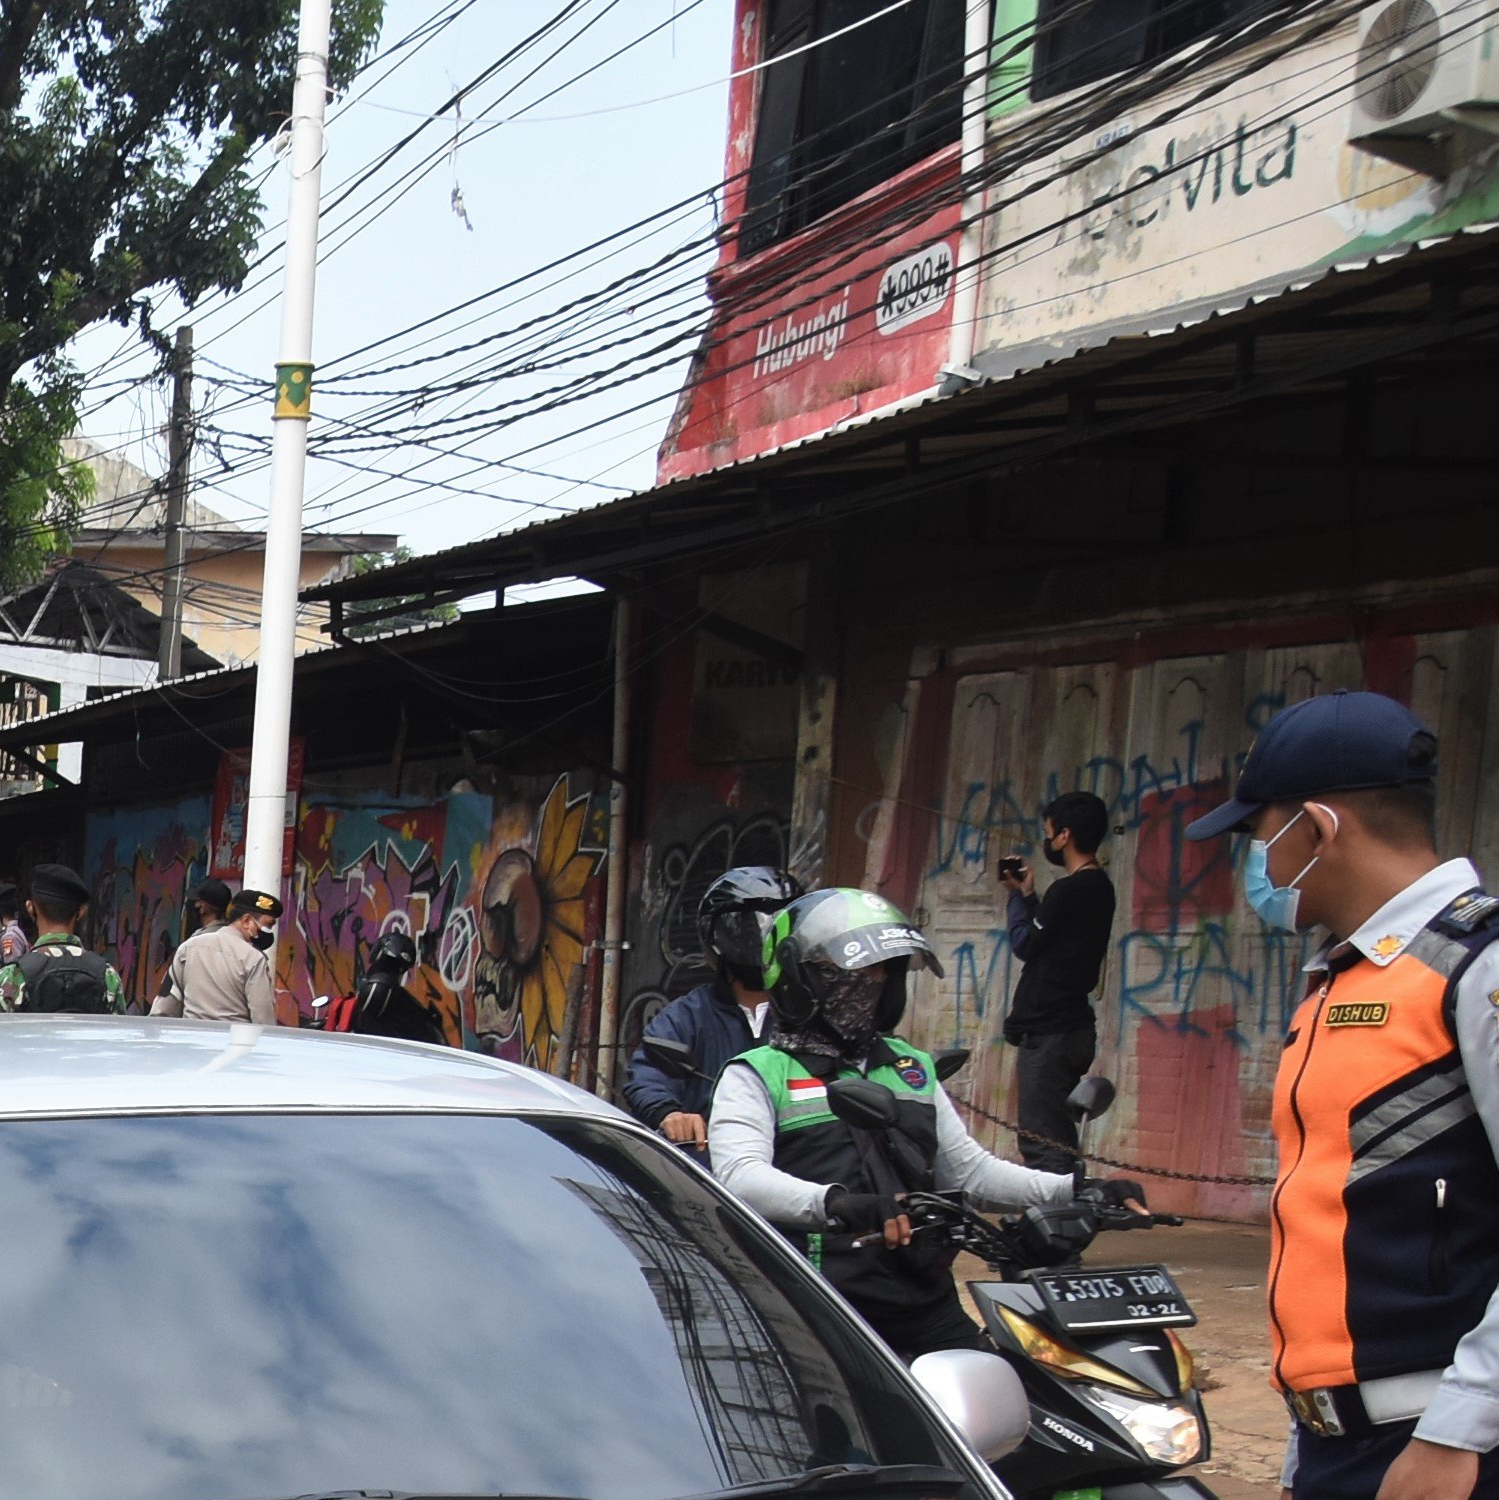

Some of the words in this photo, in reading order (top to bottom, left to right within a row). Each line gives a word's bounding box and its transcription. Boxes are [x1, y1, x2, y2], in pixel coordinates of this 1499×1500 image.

[753, 285, 850, 379] Hubungi
[1328, 1006, 1384, 1022] DISHUB
[1044, 1281, 1061, 1301] F
[1069, 1277, 1125, 1299] 5375
[1043, 1417, 1095, 1452] HONDA
